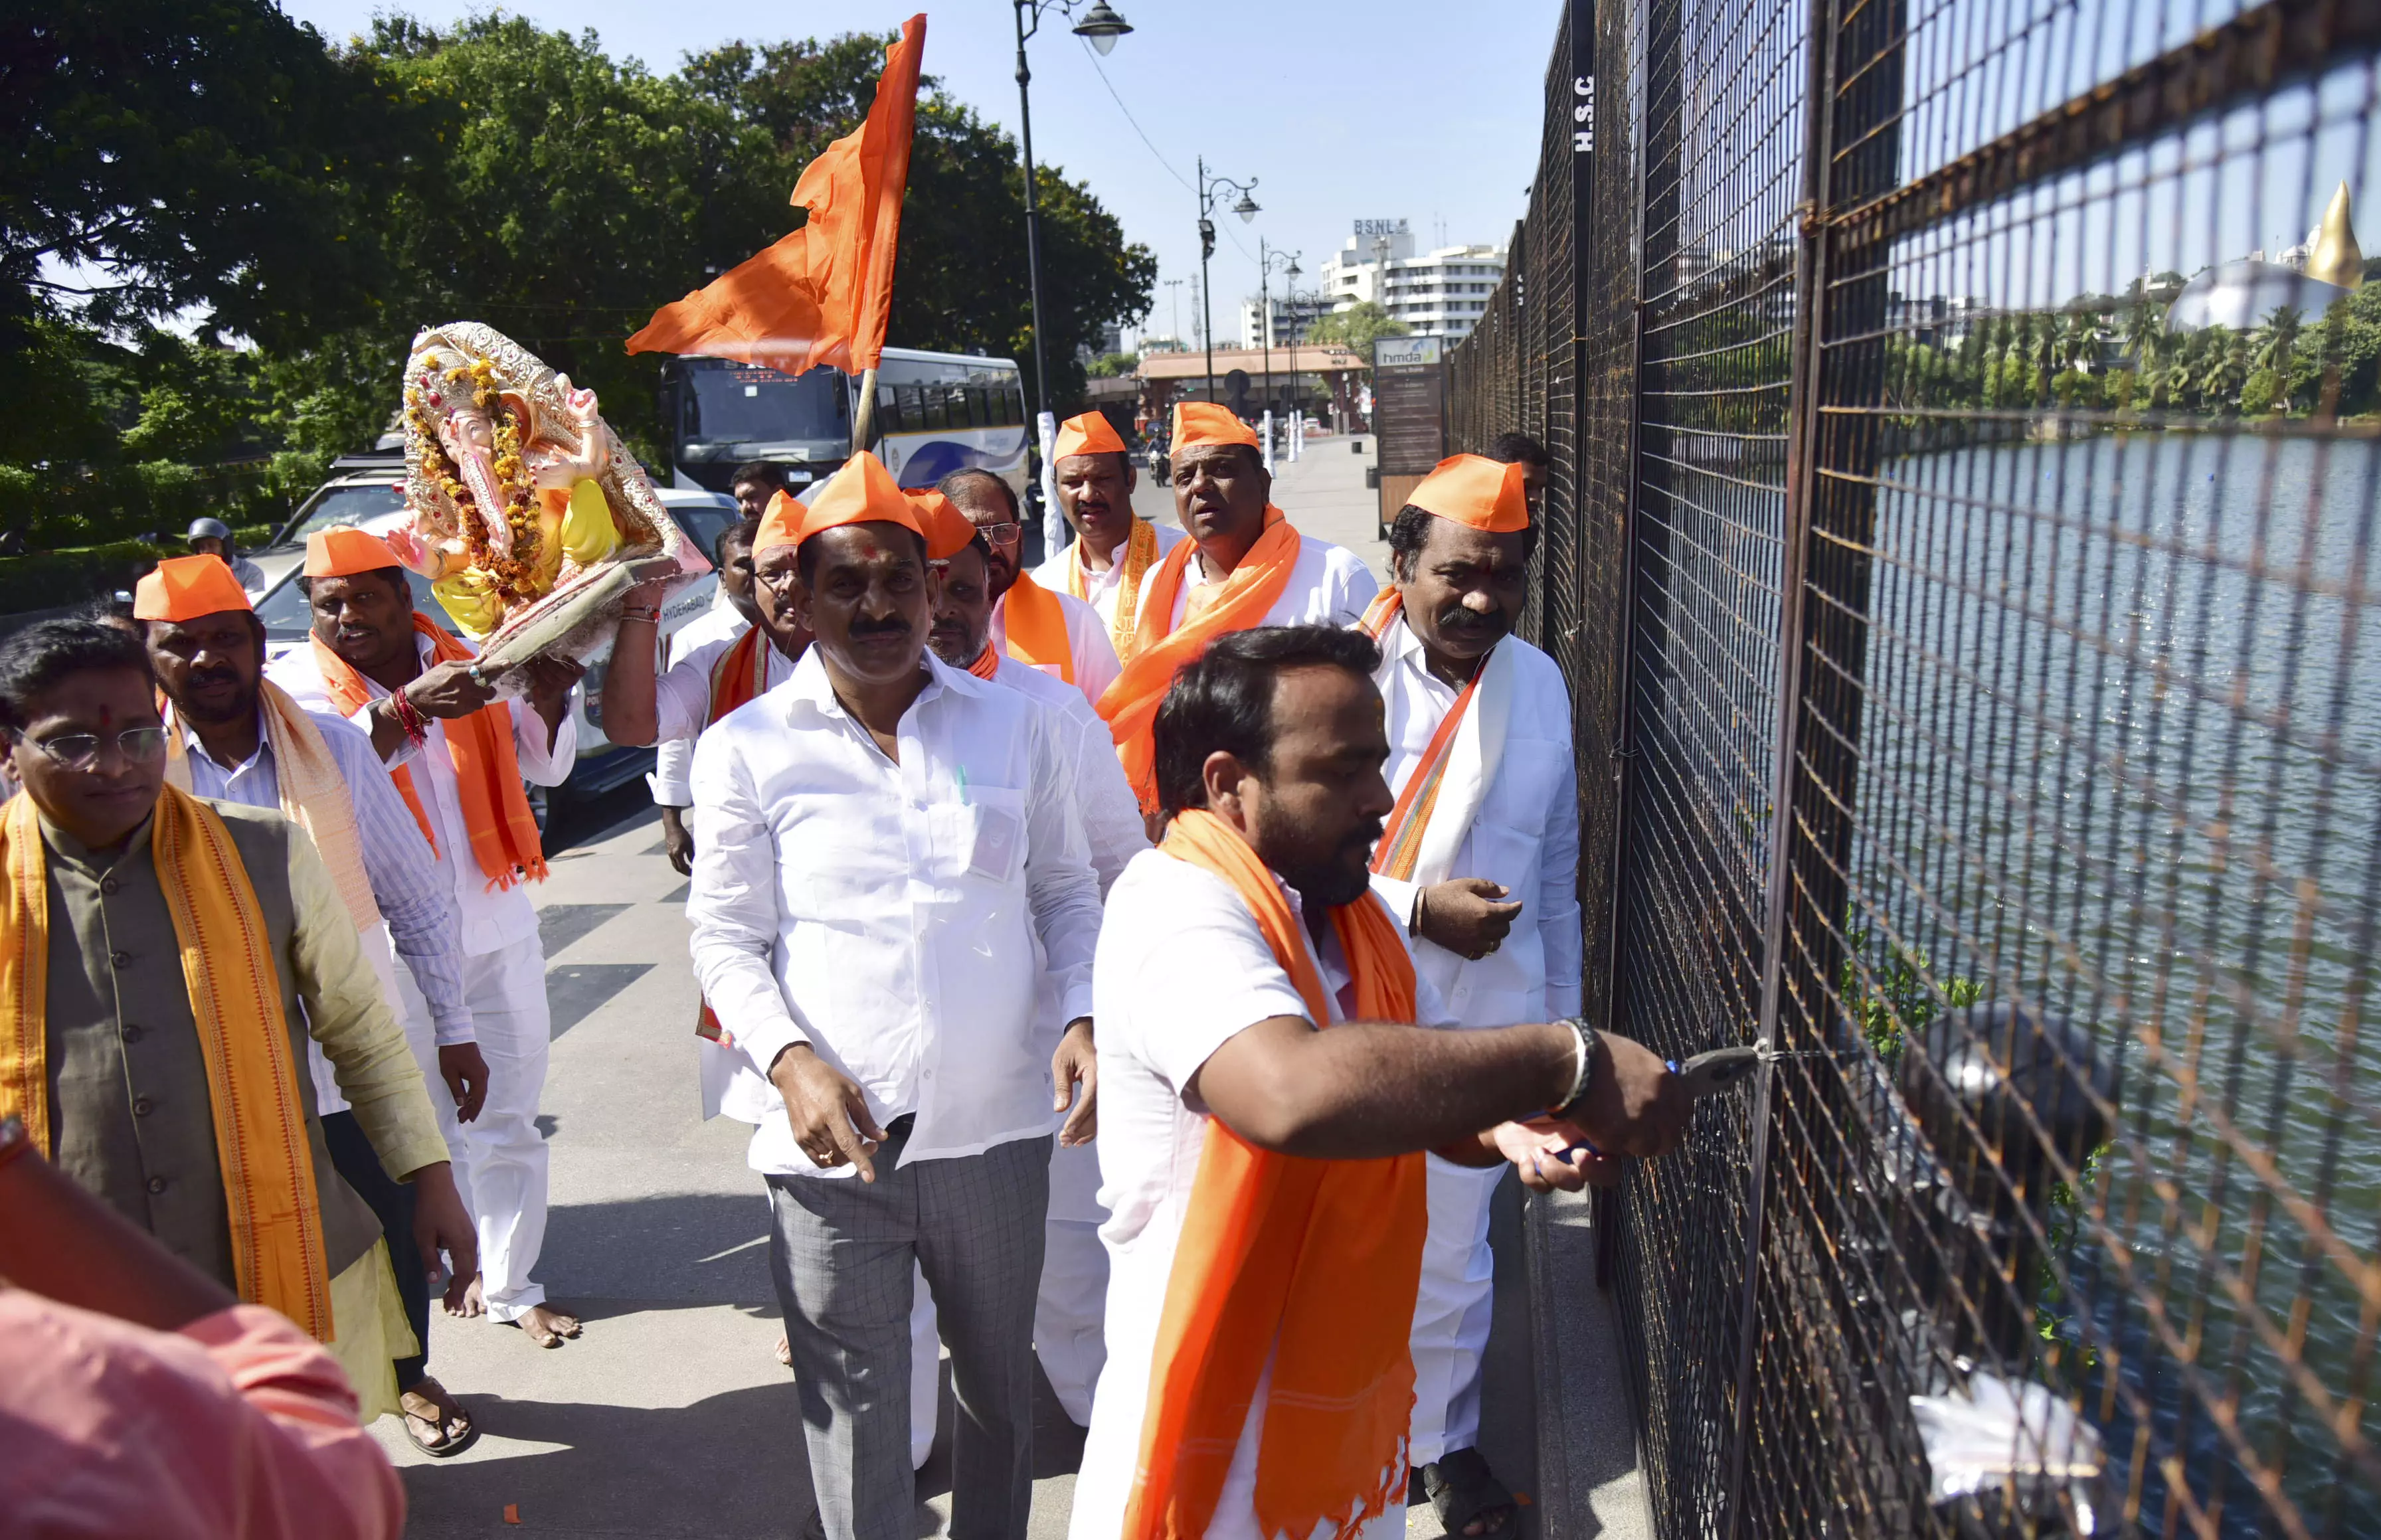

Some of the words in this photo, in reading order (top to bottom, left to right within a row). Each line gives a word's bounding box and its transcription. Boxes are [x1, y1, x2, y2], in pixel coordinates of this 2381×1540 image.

[1575, 75, 1594, 152] H.S.C
[1354, 220, 1394, 234] BSNL
[1383, 352, 1422, 363] hmda
[663, 596, 705, 622] HYDERABAD
